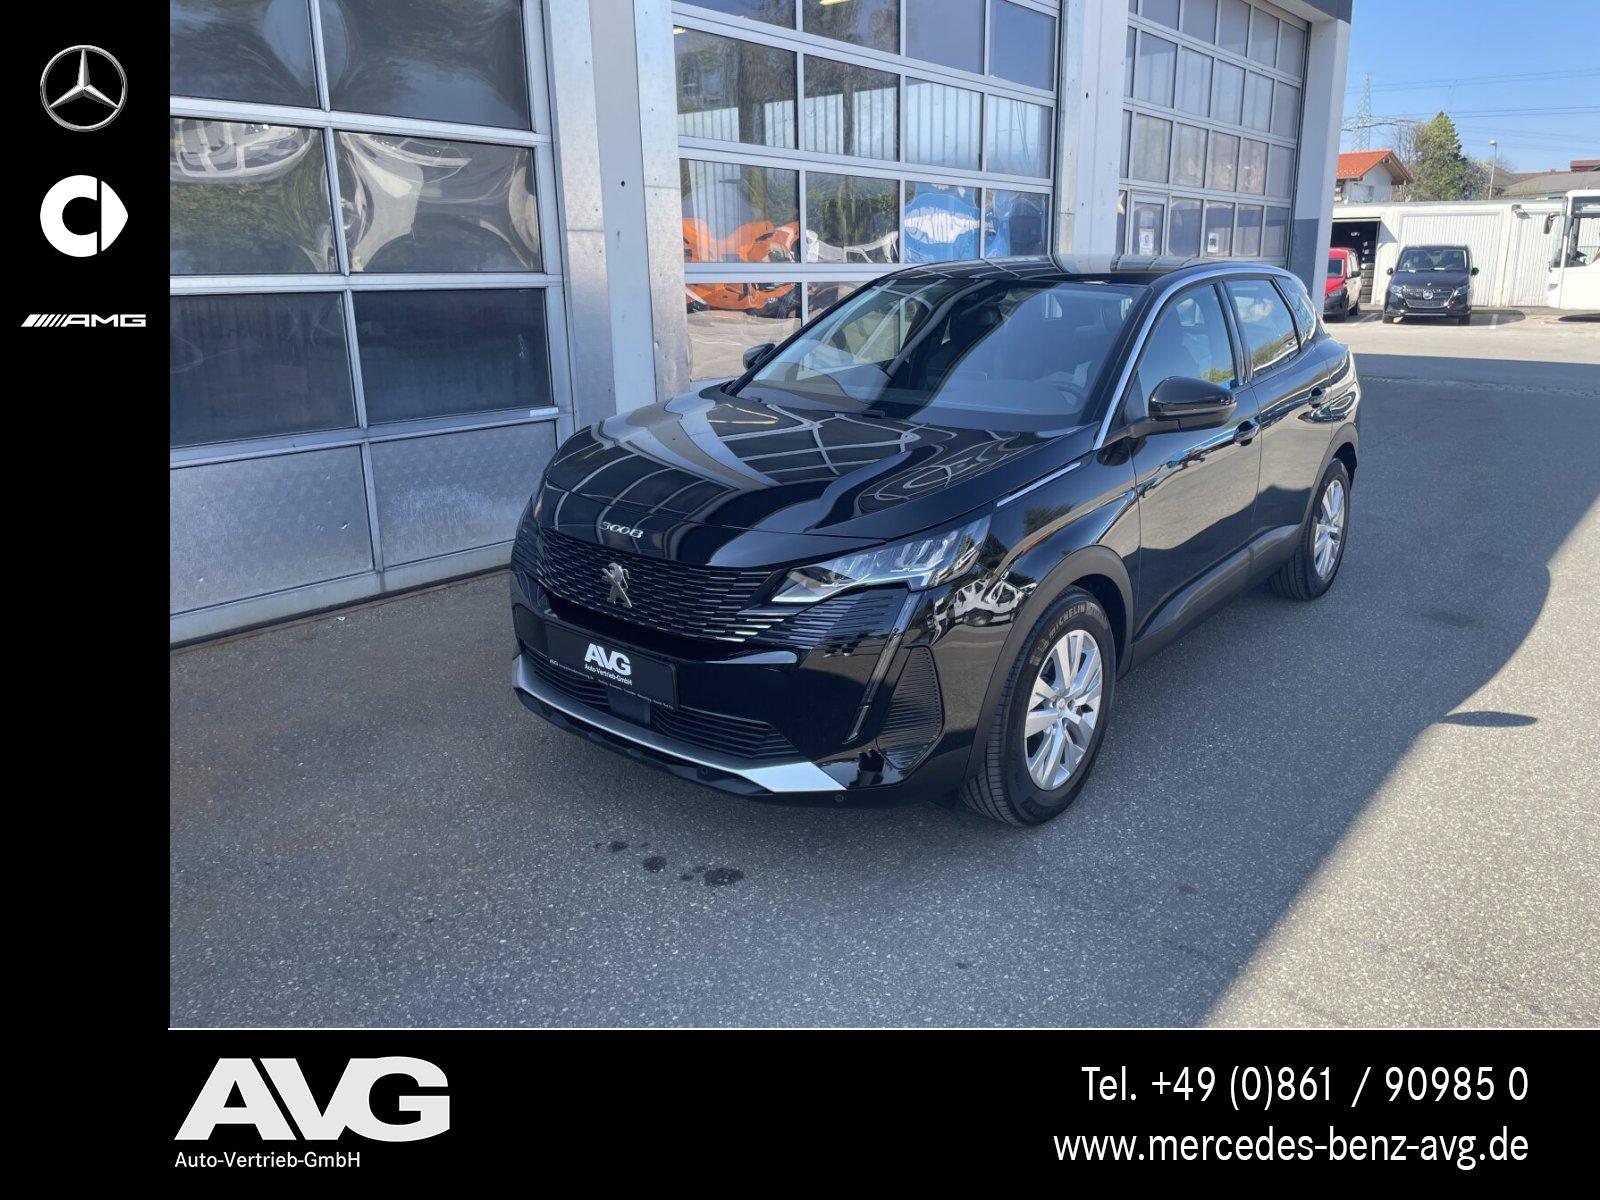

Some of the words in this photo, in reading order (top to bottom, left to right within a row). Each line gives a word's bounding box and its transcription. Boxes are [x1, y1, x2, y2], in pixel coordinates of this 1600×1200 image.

[600, 521, 644, 539] 3008
[584, 643, 632, 676] AVG
[584, 664, 633, 686] Auto-Vertrieb-GmbH
